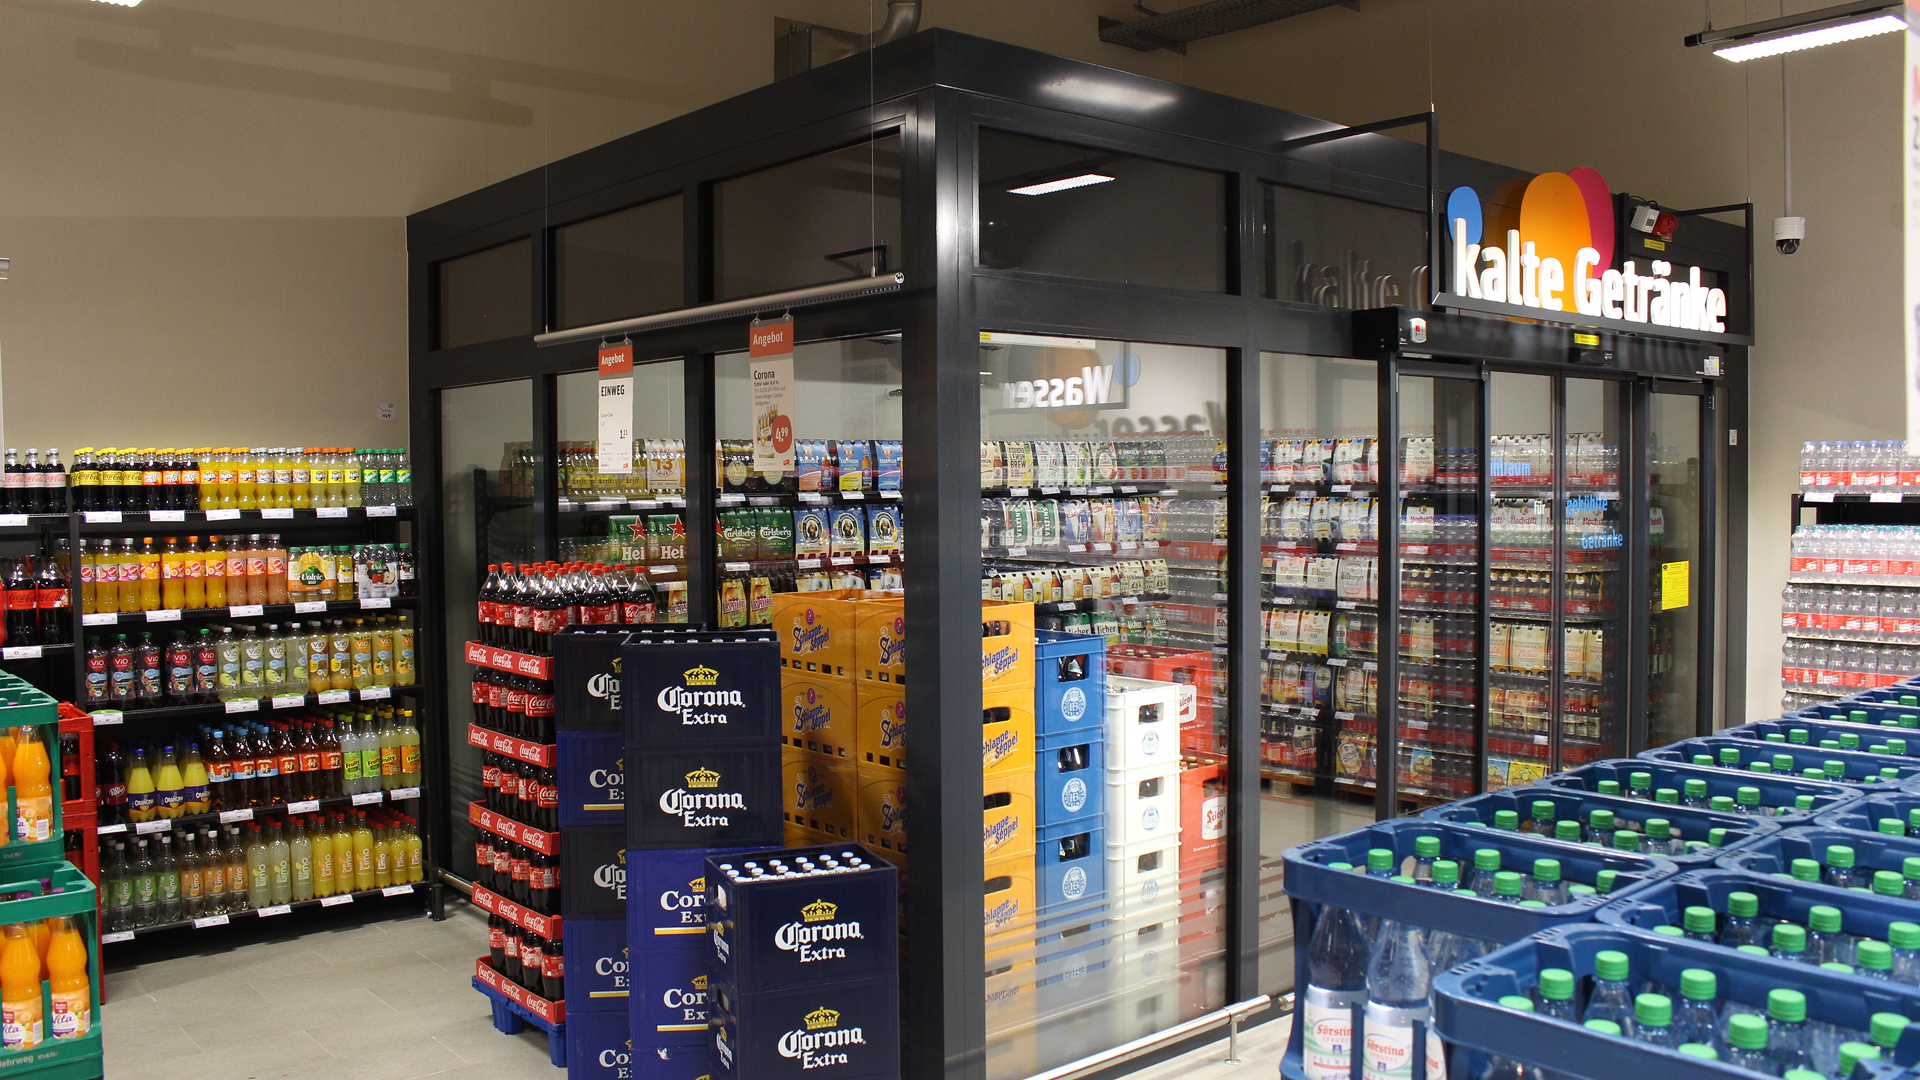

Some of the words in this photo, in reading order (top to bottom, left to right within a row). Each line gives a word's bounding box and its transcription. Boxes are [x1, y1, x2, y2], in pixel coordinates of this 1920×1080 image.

[1452, 218, 1564, 312] kalte
[1574, 246, 1727, 334] Getränke
[752, 331, 784, 347] Angebot
[601, 352, 625, 367] Angebot
[753, 370, 775, 380] Corona
[601, 384, 625, 397] EINWEG
[651, 458, 673, 470] 13
[1534, 500, 1546, 514] für
[1566, 494, 1608, 517] gekühlte
[723, 526, 756, 540] Carlsberg
[760, 526, 791, 539] Carlsberg
[1581, 529, 1623, 549] Getränke
[301, 572, 324, 581] Volvic
[587, 673, 622, 700] Co
[610, 695, 622, 711] E
[657, 685, 744, 715] Corona
[681, 708, 728, 725] Extra
[589, 769, 624, 788] Co
[608, 788, 625, 800] E
[659, 787, 744, 817] Corona
[683, 810, 729, 828] Extra
[1206, 804, 1226, 824] Stiegl
[593, 863, 627, 890] Co
[616, 885, 627, 900] E
[660, 890, 706, 911] Cor
[681, 911, 706, 924] Ex
[713, 928, 730, 956] Corona
[774, 920, 862, 952] Corona
[799, 945, 846, 964] Extra
[595, 957, 629, 976] Co
[614, 976, 630, 987] E
[663, 988, 708, 1009] Cor
[683, 1009, 708, 1021] Ex
[716, 1034, 733, 1063] Corona
[777, 1026, 864, 1060] Corona
[1366, 1038, 1404, 1056] Förstina
[0, 1055, 34, 1068] ehrweg
[599, 1049, 632, 1068] Co
[802, 1052, 848, 1070] Extra
[1314, 1055, 1347, 1066] PREMI
[617, 1068, 632, 1079] E
